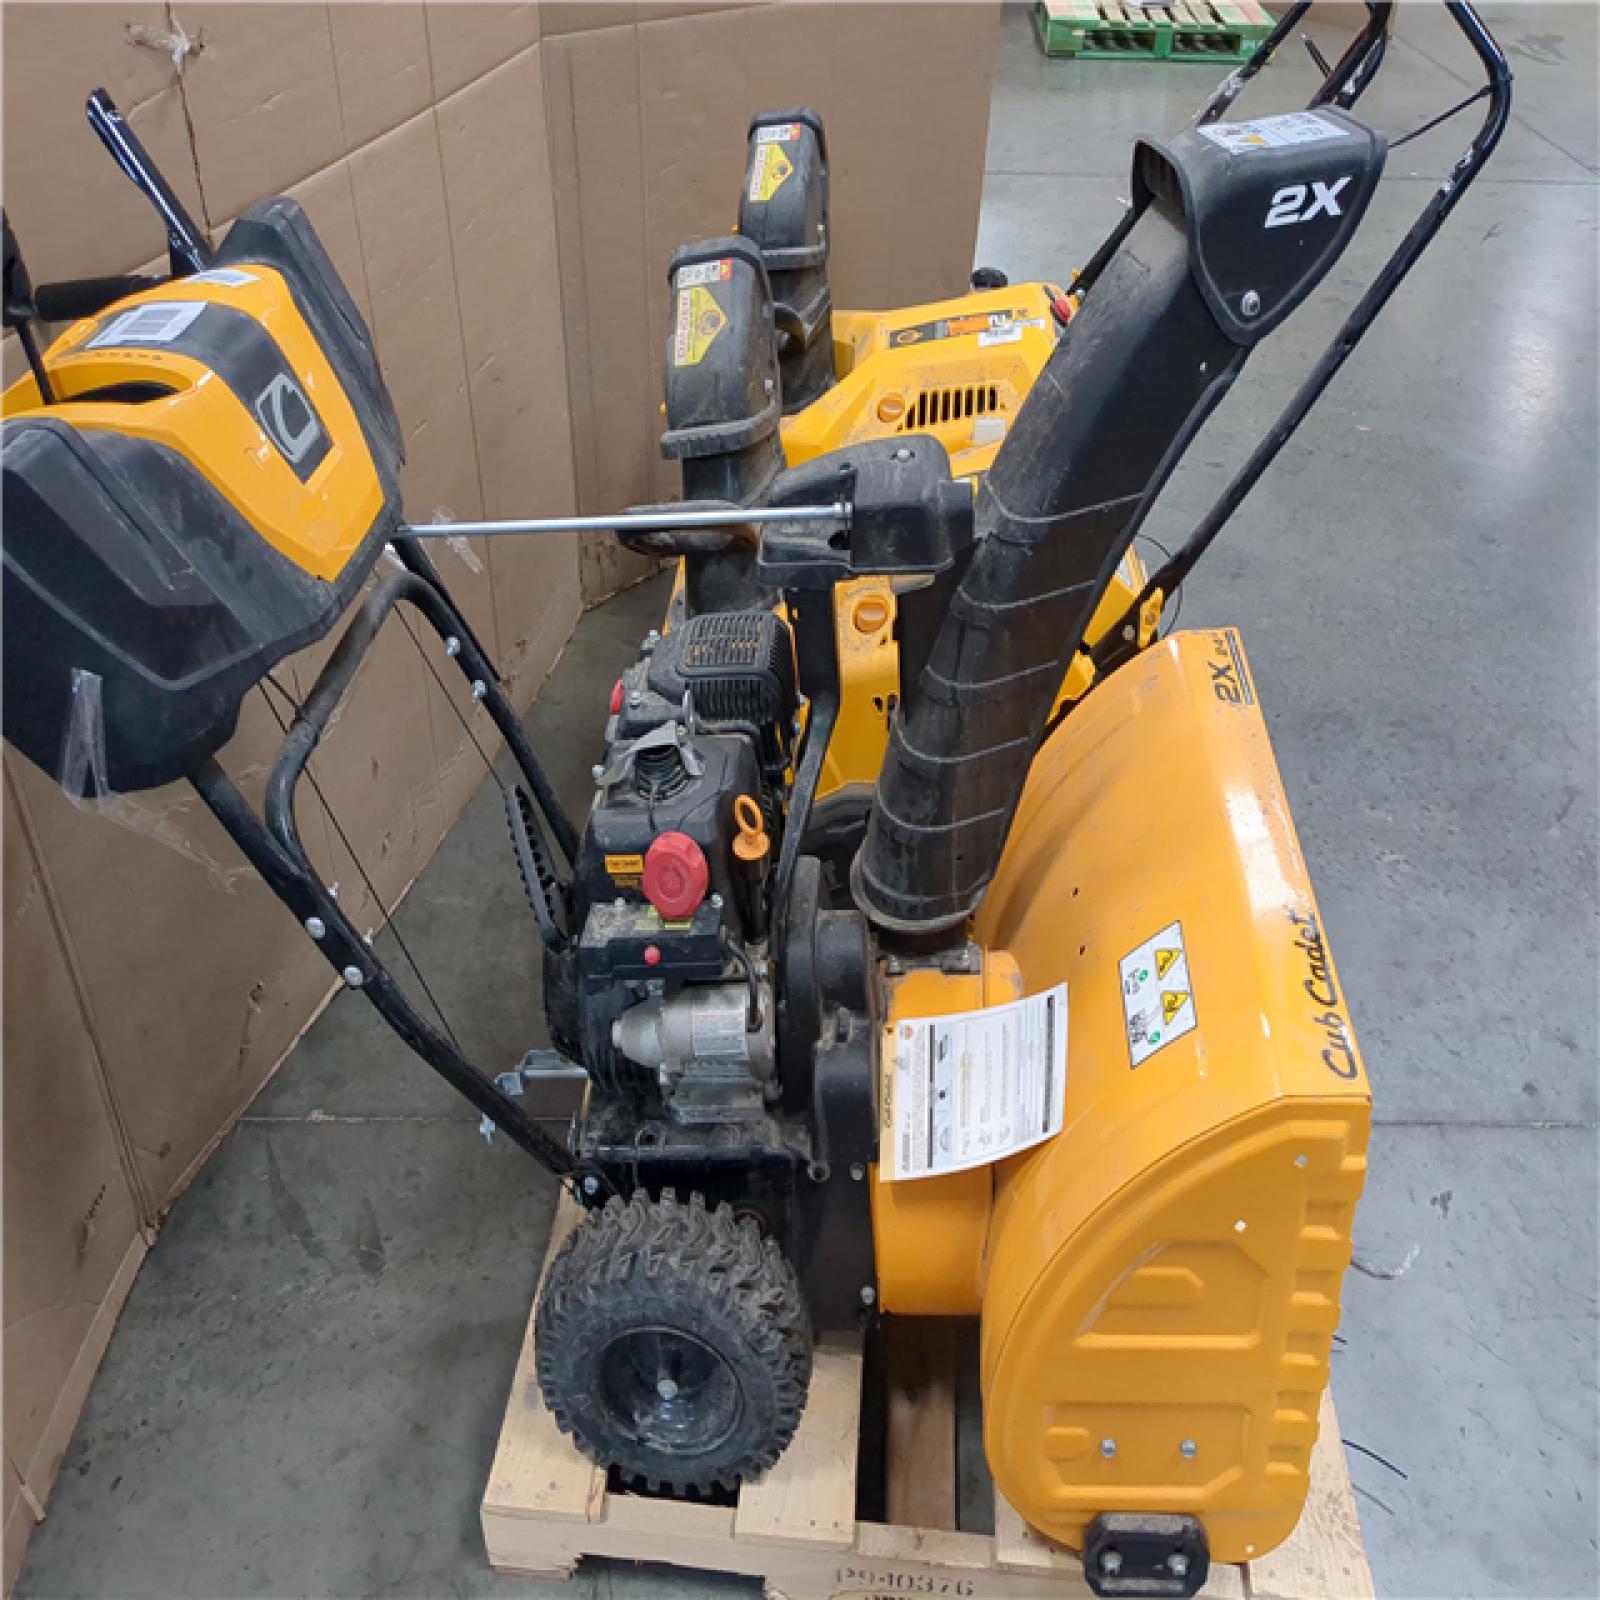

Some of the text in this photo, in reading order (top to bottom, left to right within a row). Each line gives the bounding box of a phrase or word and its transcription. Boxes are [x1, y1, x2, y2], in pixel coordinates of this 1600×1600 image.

[1264, 176, 1352, 228] 2X
[1208, 661, 1241, 703] 2X
[1287, 909, 1358, 1080] Cub Cadet
